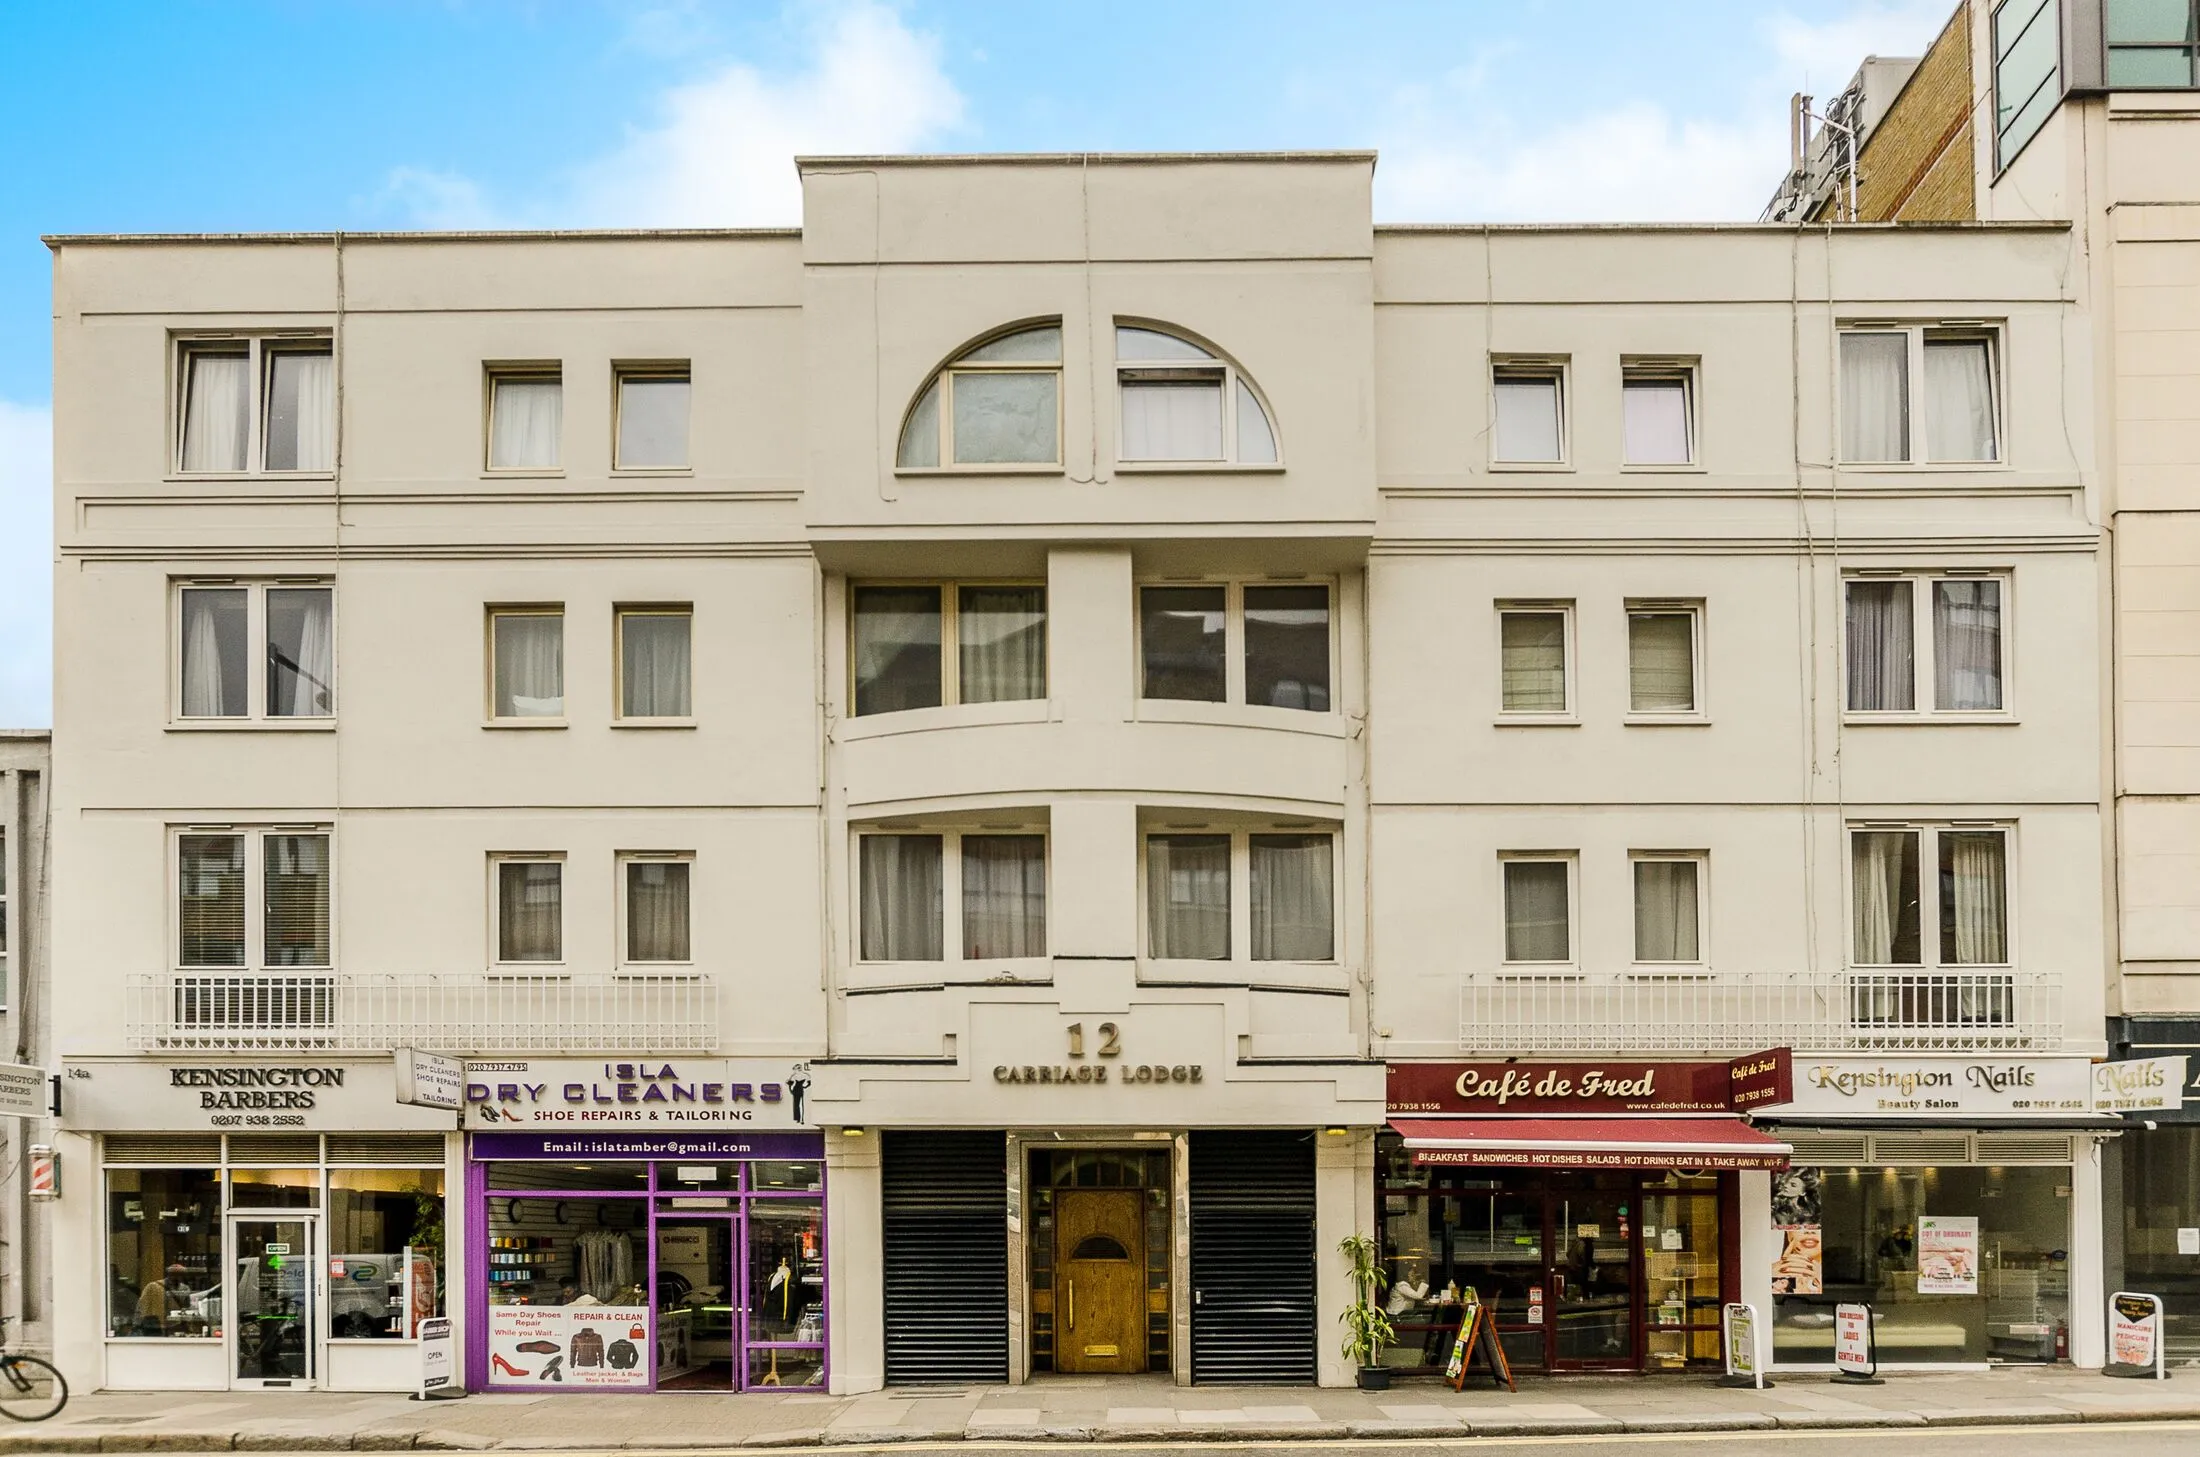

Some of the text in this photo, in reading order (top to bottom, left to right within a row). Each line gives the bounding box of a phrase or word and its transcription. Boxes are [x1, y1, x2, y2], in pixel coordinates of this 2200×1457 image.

[1066, 1022, 1121, 1058] 12
[415, 1063, 460, 1078] DRY CLEANERS
[604, 1063, 680, 1081] ISLA
[992, 1065, 1203, 1084] CARRIAGE LODGE
[1731, 1057, 1776, 1081] Café de Fred
[170, 1068, 345, 1087] KENSINGTON
[416, 1073, 461, 1088] SHOE REPAIRS
[1808, 1065, 2036, 1097] Kensington Nails
[2096, 1062, 2164, 1098] Nails
[466, 1083, 784, 1103] DRY CLEANERS
[1455, 1069, 1656, 1105] Café de Fred
[199, 1090, 316, 1110] BARBERS
[422, 1093, 457, 1105] TAILORING
[1735, 1086, 1775, 1104] 020 7938 1556
[1626, 1101, 1726, 1110] www.cafedefred.co.uk
[1878, 1099, 1959, 1110] Beauty Salon
[2012, 1101, 2030, 1109] 020
[211, 1115, 305, 1126] 0207 938 2552
[533, 1111, 753, 1121] SHOE REPAIRS & TAILORING
[1418, 1153, 1469, 1162] BREAKFAST
[1472, 1153, 1529, 1163] SANDWICHES
[1532, 1154, 1551, 1163] HOT
[1551, 1155, 1583, 1164] DISHES
[1586, 1155, 1621, 1165] SALADS
[1624, 1156, 1642, 1165] HOT
[1643, 1156, 1675, 1165] DRINKS
[1676, 1156, 1693, 1166] EAT
[1694, 1157, 1703, 1166] IN
[1704, 1157, 1711, 1166] &
[1712, 1157, 1735, 1167] TAKE
[1736, 1157, 1760, 1167] AWAY
[515, 1319, 541, 1327] Repair
[519, 1311, 535, 1320] Day
[537, 1311, 562, 1319] Shoes
[573, 1313, 643, 1321] REPAIR & CLEAN
[494, 1329, 517, 1337] While
[534, 1329, 552, 1337] Wait
[427, 1351, 443, 1360] OPEN
